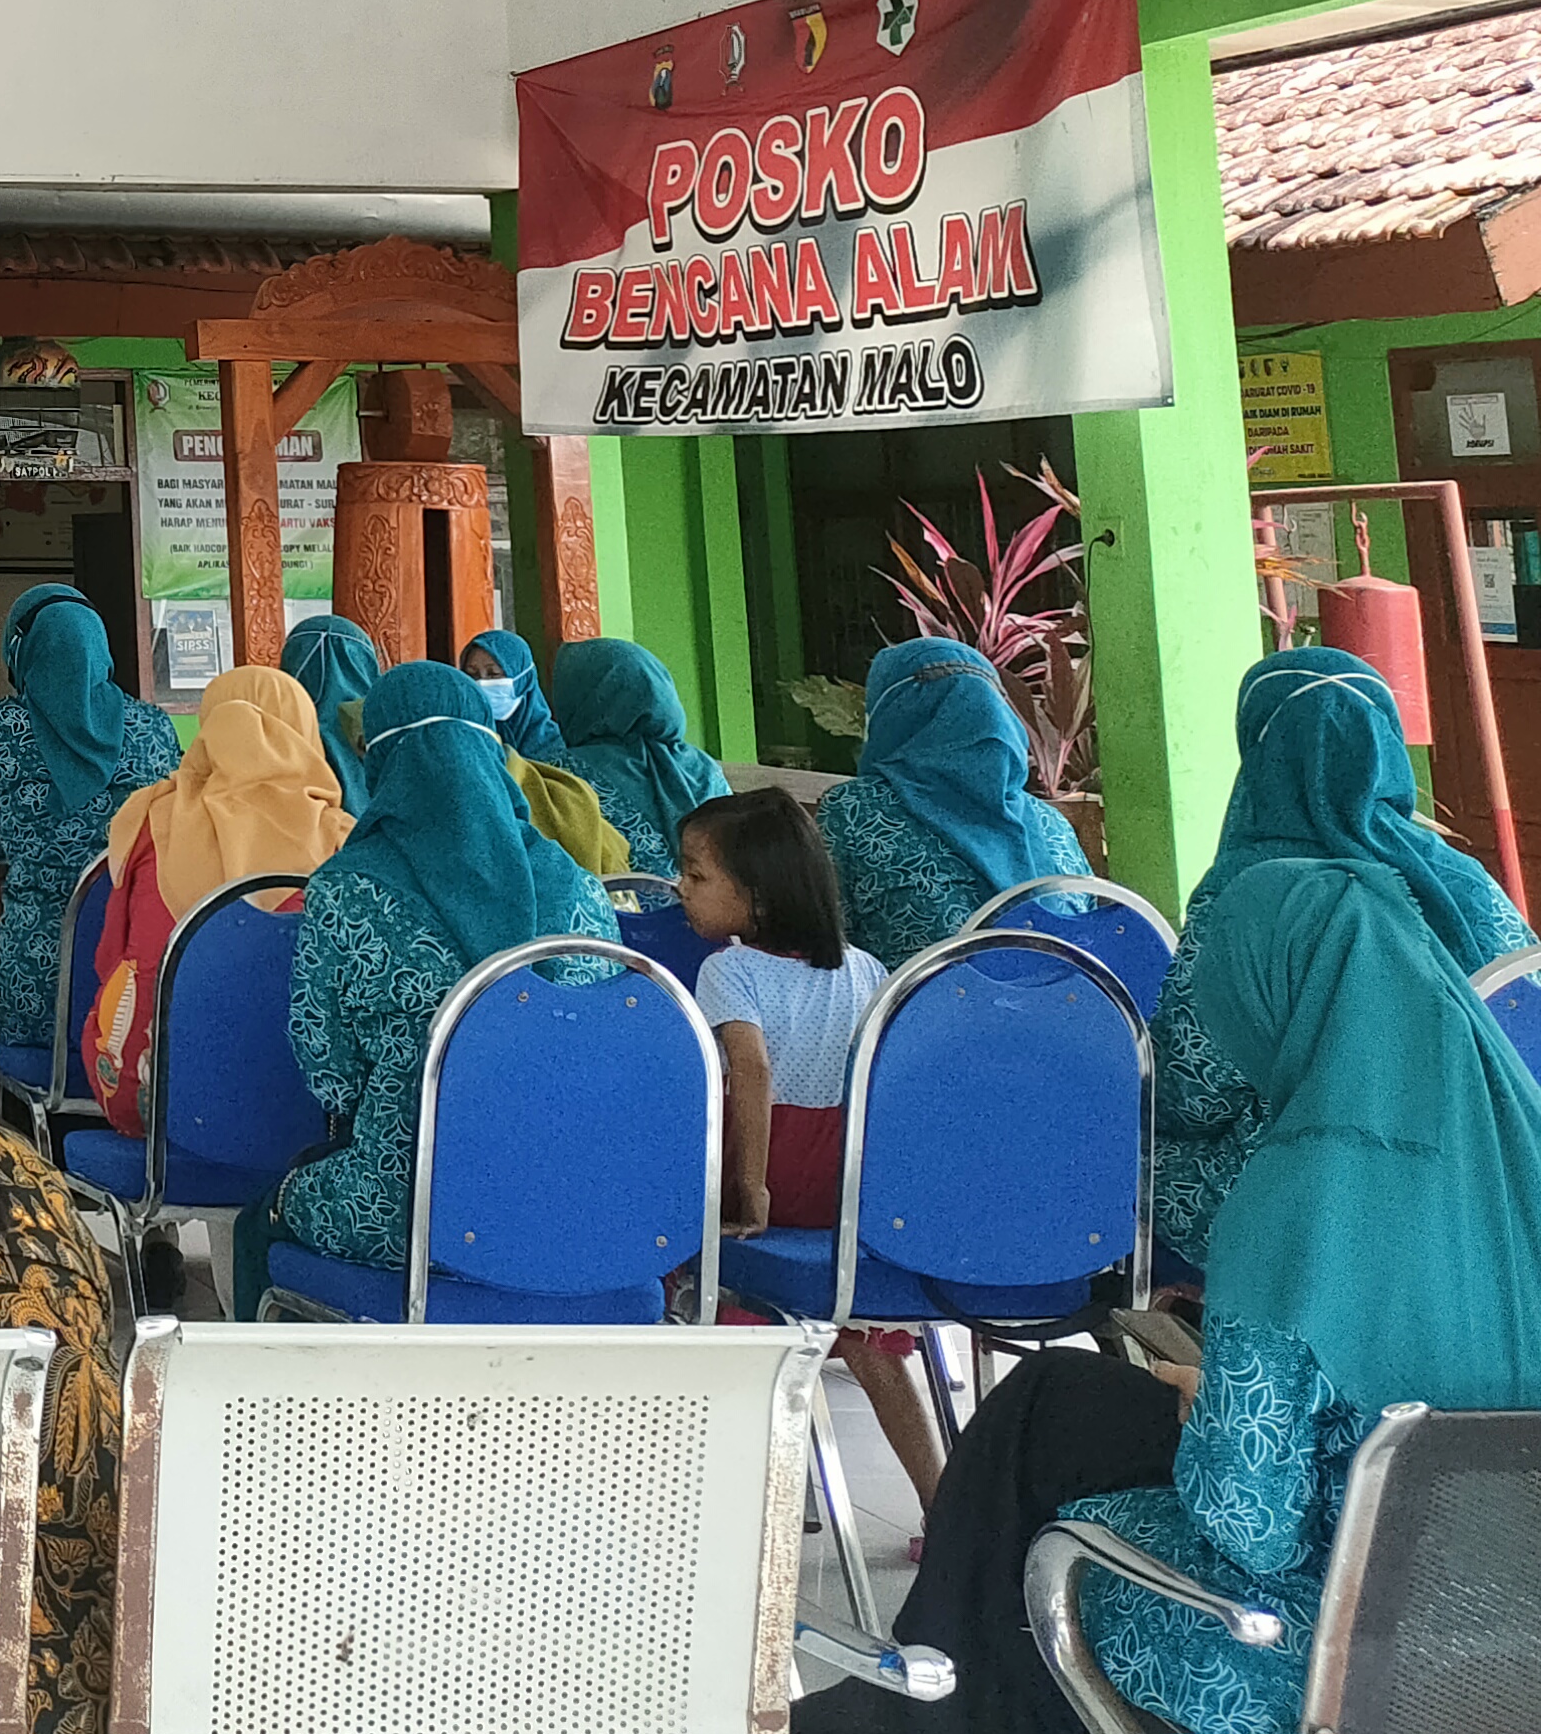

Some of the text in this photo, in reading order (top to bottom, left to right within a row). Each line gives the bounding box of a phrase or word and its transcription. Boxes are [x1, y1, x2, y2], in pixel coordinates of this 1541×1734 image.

[648, 86, 926, 251] POSKO
[560, 199, 1044, 349] BENCANA ALAM
[594, 334, 985, 426] KECAMATAN MALO
[1277, 385, 1301, 396] COVID
[1259, 407, 1279, 418] DIAM
[1281, 407, 1289, 417] DI
[1291, 405, 1321, 417] RUMAH
[1248, 426, 1290, 437] DARIPADA
[1290, 444, 1314, 454] SAKIT
[15, 466, 52, 477] SATPOL
[157, 479, 337, 489] BAGI MASYAR MATAN MAL
[157, 498, 182, 508] YANG
[185, 499, 211, 508] AKAN
[280, 499, 304, 508] URAT
[161, 518, 193, 528] HARAP
[281, 518, 305, 528] ARTU
[309, 518, 335, 528] VAKS
[194, 544, 227, 552] HADCOP
[303, 543, 332, 553] MELAL
